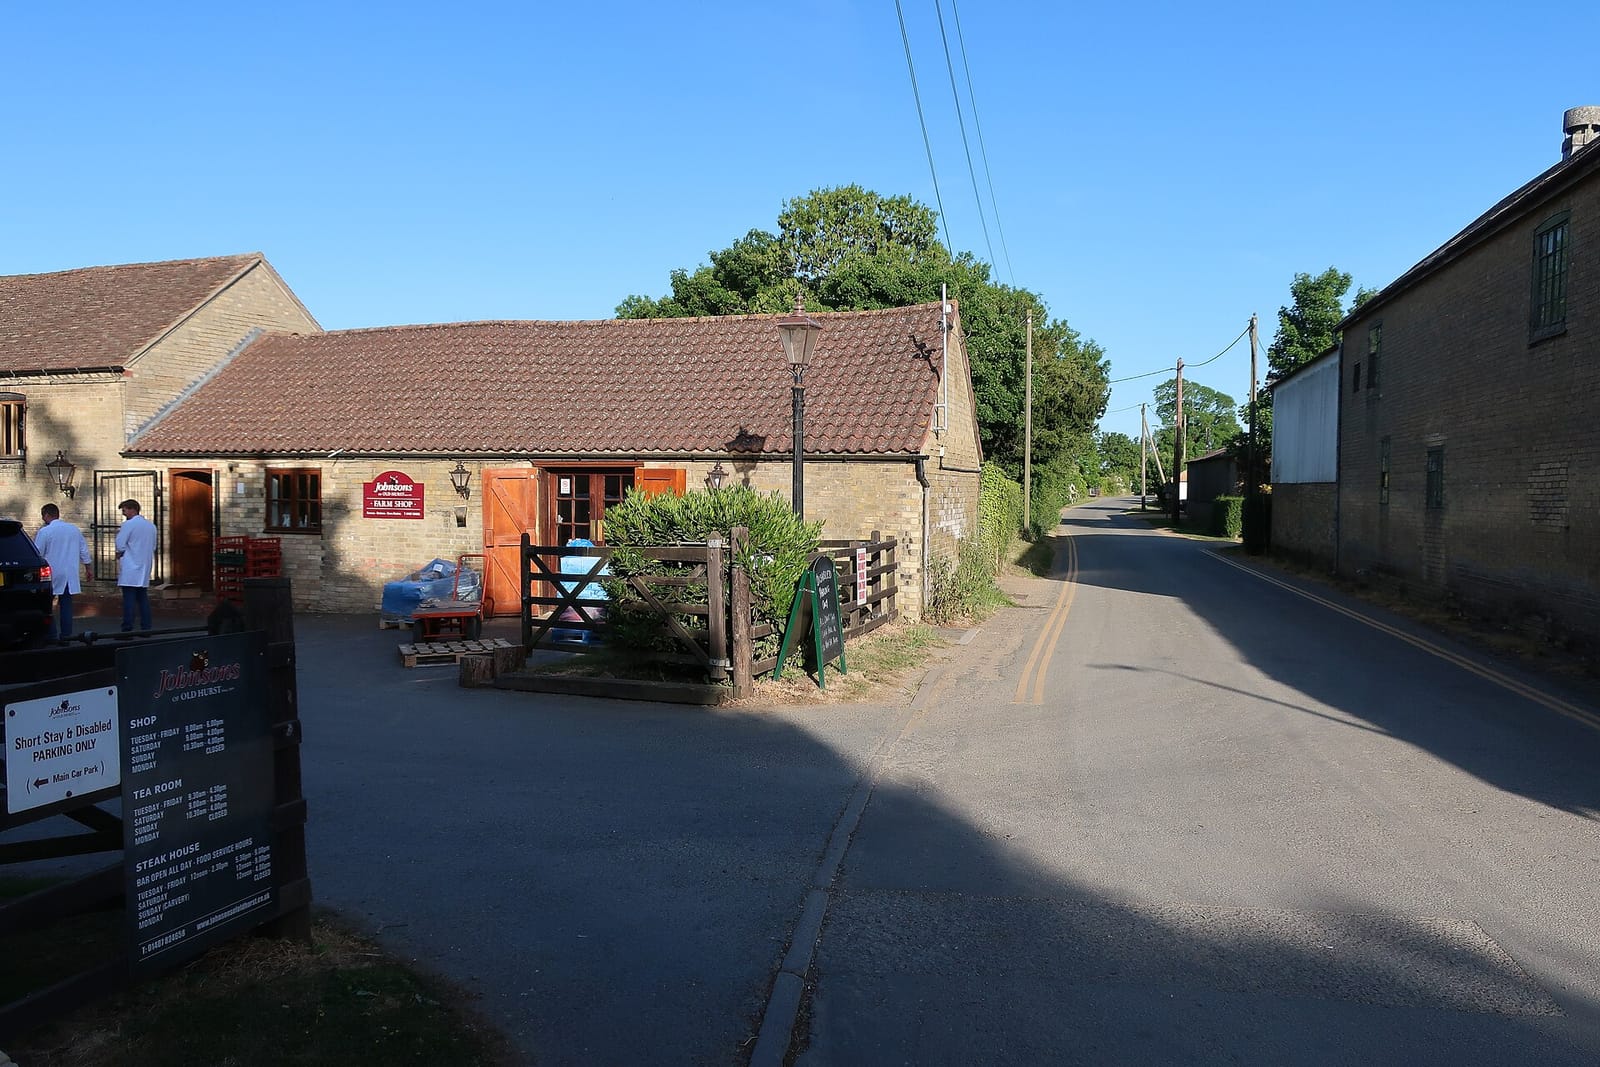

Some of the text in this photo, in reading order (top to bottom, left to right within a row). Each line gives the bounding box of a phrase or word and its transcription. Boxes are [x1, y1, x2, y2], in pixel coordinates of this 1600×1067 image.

[374, 482, 413, 492] Johnsons
[153, 662, 241, 699] Johnsons
[180, 691, 197, 700] OLD
[198, 686, 222, 698] HURST
[130, 715, 157, 729] SHOP
[15, 719, 112, 750] Short Stay & Disabled
[131, 732, 157, 745] TUESDAY
[160, 728, 180, 738] FRIDAY
[33, 738, 96, 762] PARKING ONLY
[131, 741, 161, 755] SATURDAY
[131, 752, 155, 764] SUNDAY
[132, 744, 225, 774] MONDAY CLOSED
[52, 774, 70, 783] Main
[72, 770, 82, 778] Car
[84, 765, 98, 775] Park
[133, 779, 182, 800] TEA ROOM
[134, 802, 160, 817] TUESDAY
[163, 796, 183, 808] FRIDAY
[134, 811, 164, 827] SATURDAY
[135, 809, 228, 845] MONDAY CLOSED
[135, 822, 158, 836] SUNDAY
[136, 842, 200, 872] STEAK HOUSE
[136, 876, 150, 887] BAR
[151, 868, 167, 882] OPEN
[168, 865, 179, 876] ALL
[180, 860, 193, 871] DAY
[196, 853, 212, 865] FOOD
[212, 844, 234, 859] SERVICE
[138, 885, 164, 901] TUESDAY
[167, 876, 186, 890] FRIDAY
[138, 893, 168, 911] SATURDAY
[138, 904, 162, 920] SUNDAY
[138, 914, 163, 929] MONDAY
